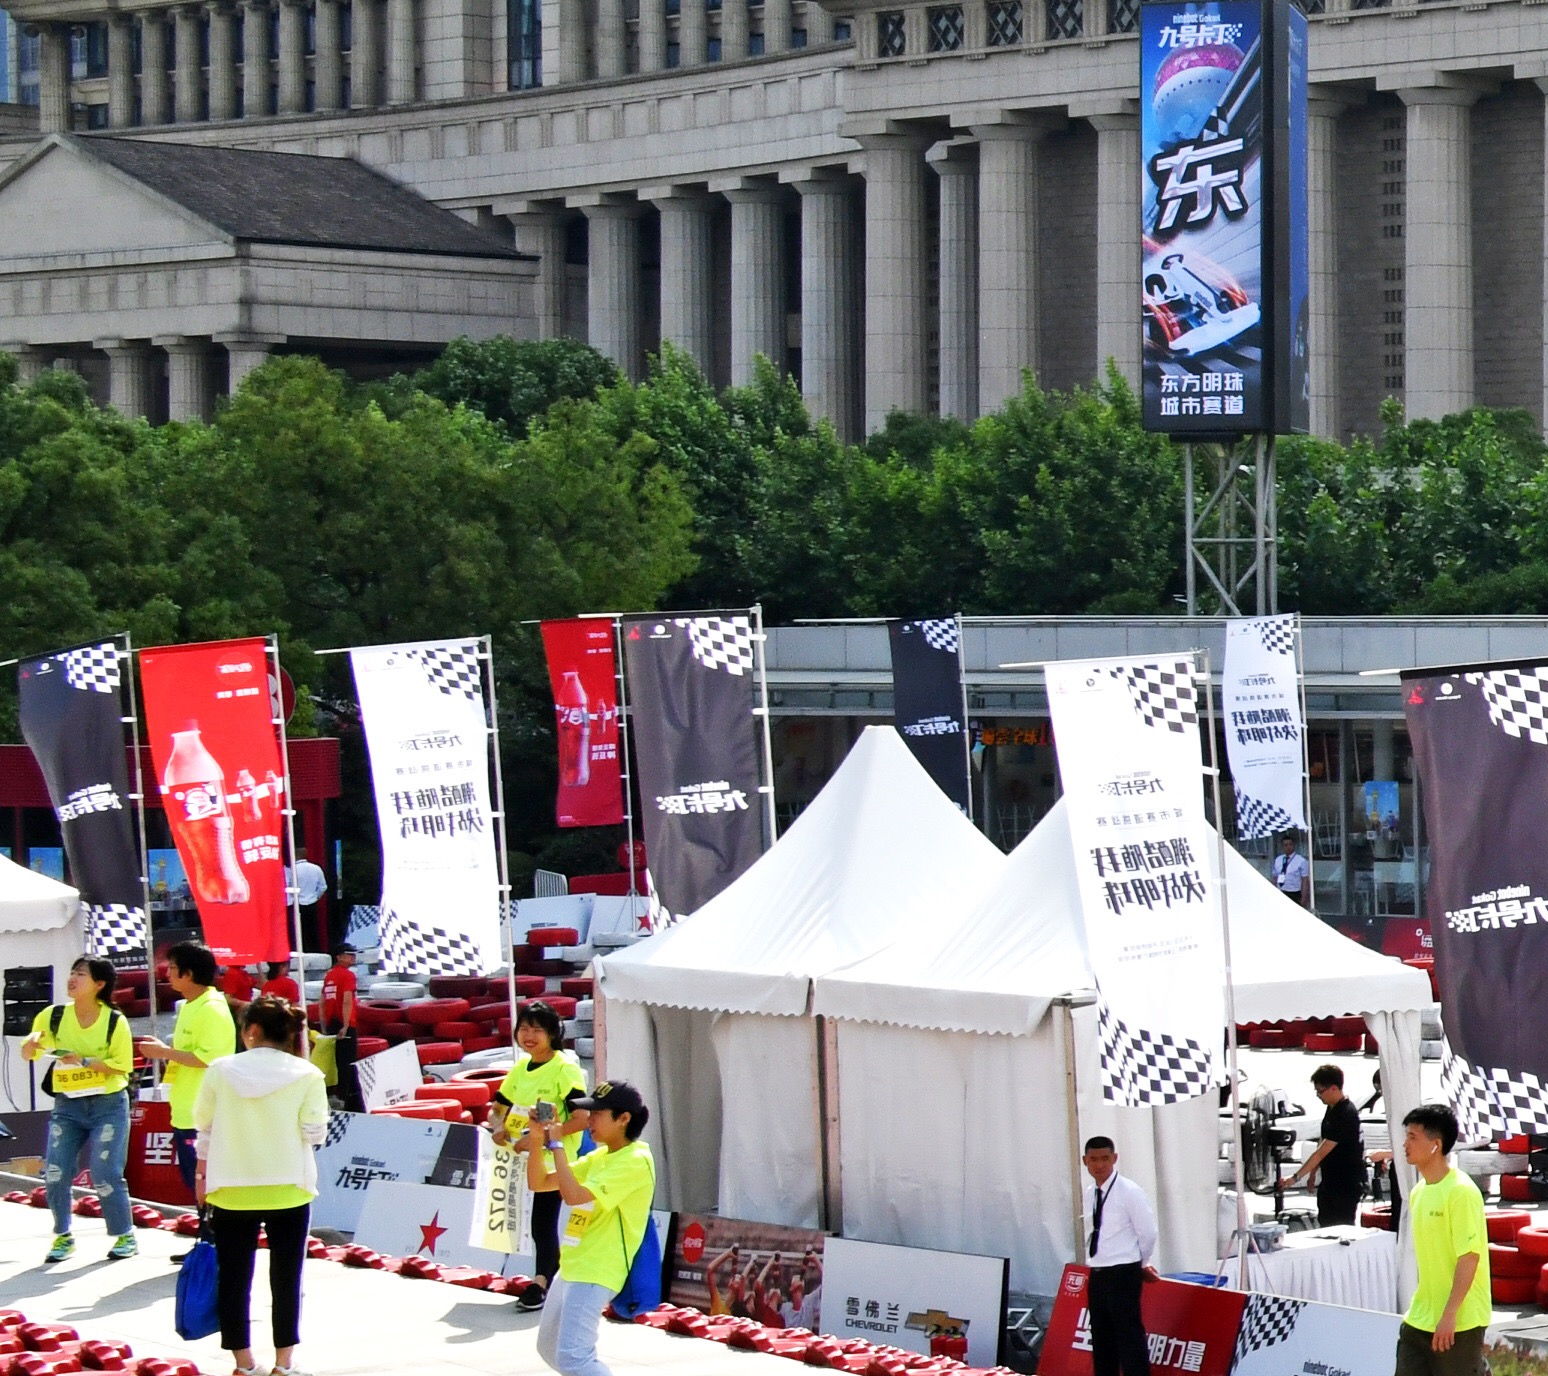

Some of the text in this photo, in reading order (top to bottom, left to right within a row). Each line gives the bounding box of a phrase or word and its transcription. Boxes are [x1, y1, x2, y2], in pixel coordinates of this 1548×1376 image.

[1159, 23, 1228, 48] 九号卡丁
[1157, 132, 1244, 229] 东
[1160, 372, 1244, 393] 东方明珠
[1160, 395, 1244, 415] 城市赛道
[846, 1296, 899, 1321] 雪佛兰
[845, 1318, 898, 1334] CHEVROLET
